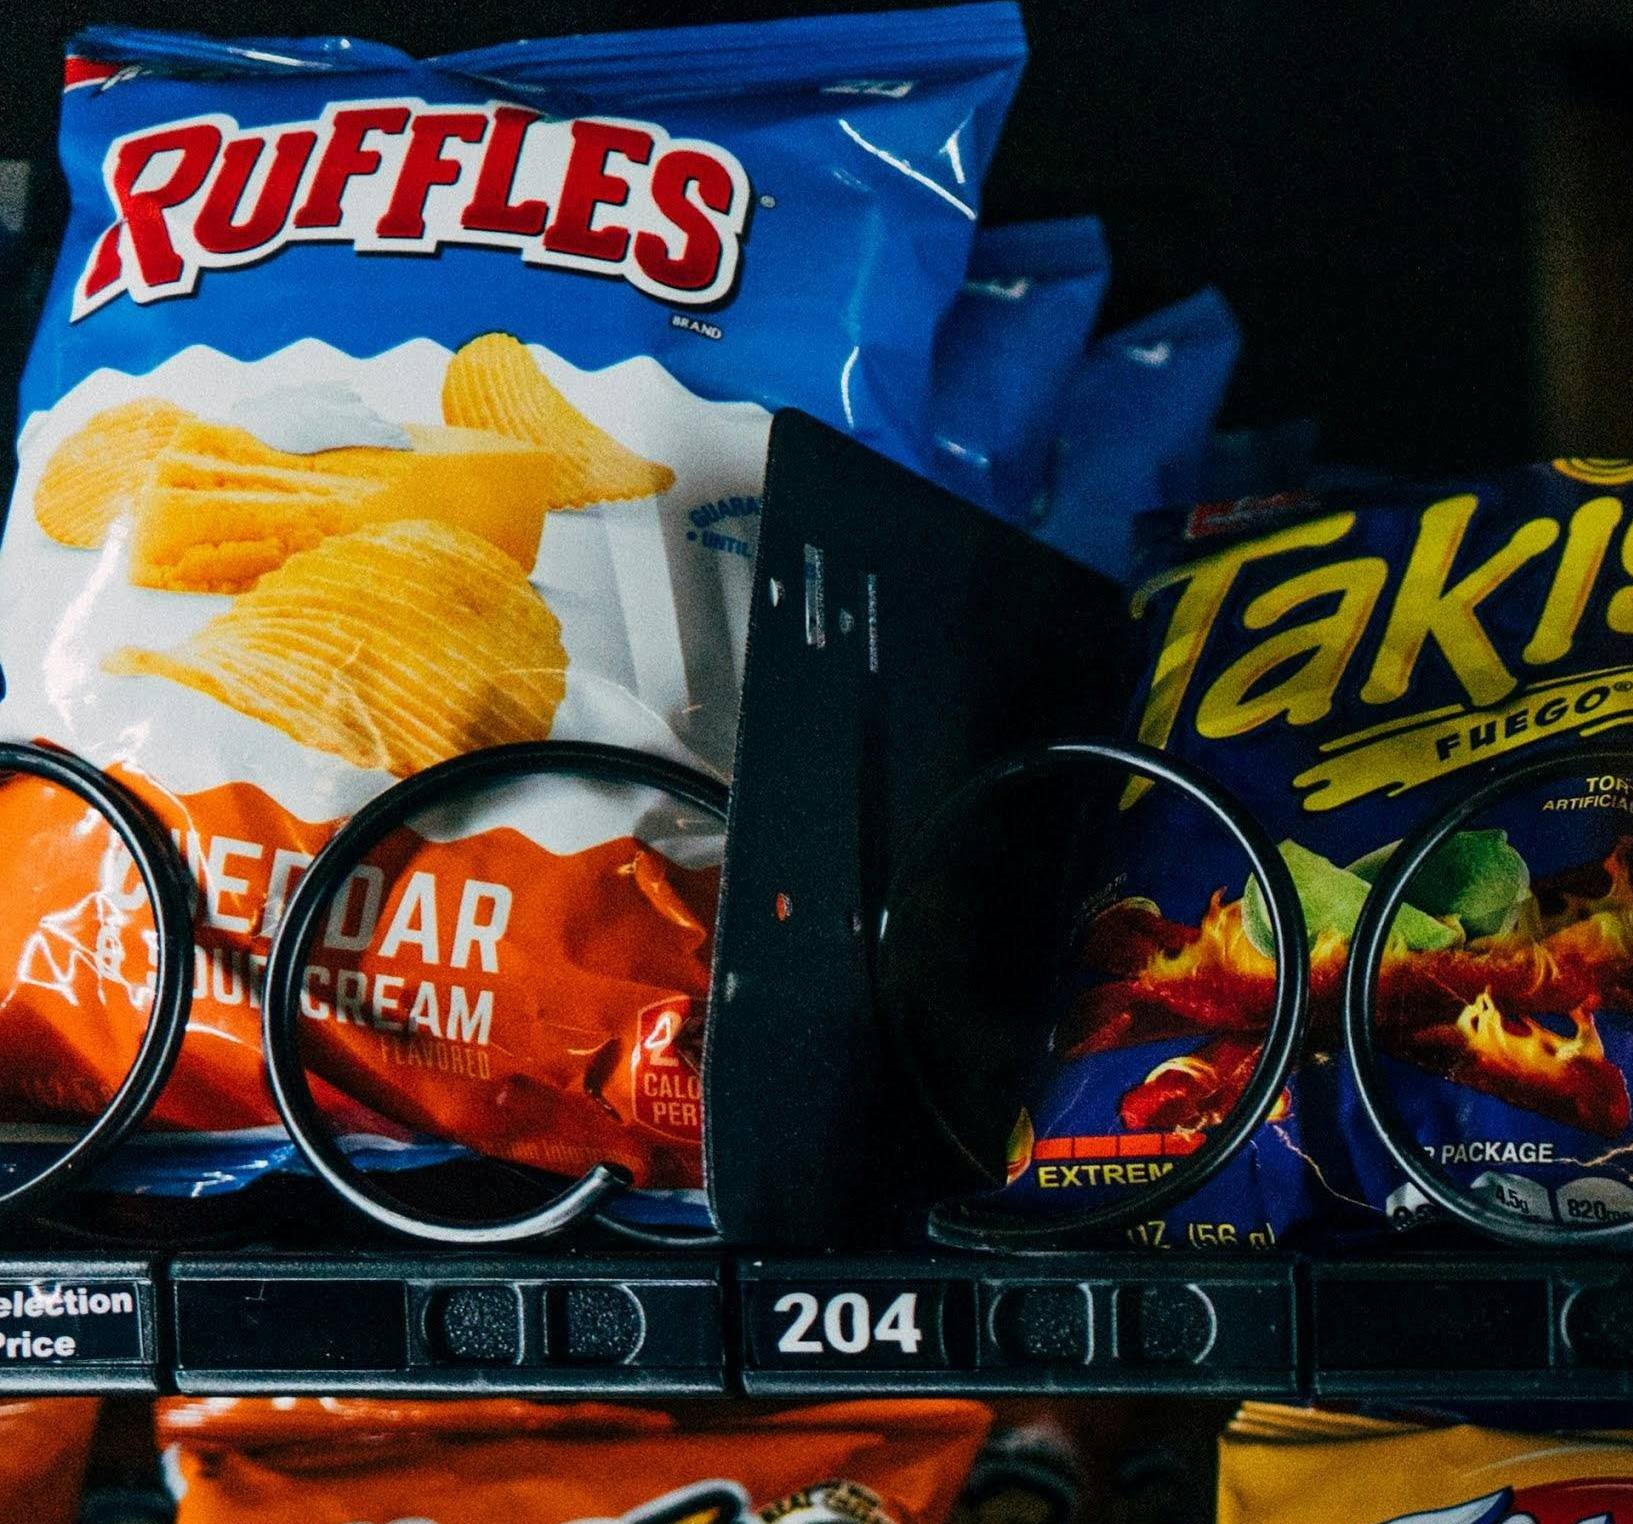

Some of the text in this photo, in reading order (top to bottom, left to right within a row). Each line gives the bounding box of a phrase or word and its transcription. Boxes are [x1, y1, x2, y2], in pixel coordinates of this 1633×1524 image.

[82, 103, 740, 294] RUFFLES
[671, 314, 722, 340] BRAND
[1435, 685, 1606, 763] FUEGO
[301, 964, 496, 1046] CREAM
[652, 1102, 699, 1127] PER
[1440, 1141, 1554, 1166] PACKAGE
[774, 1290, 924, 1355] 204
